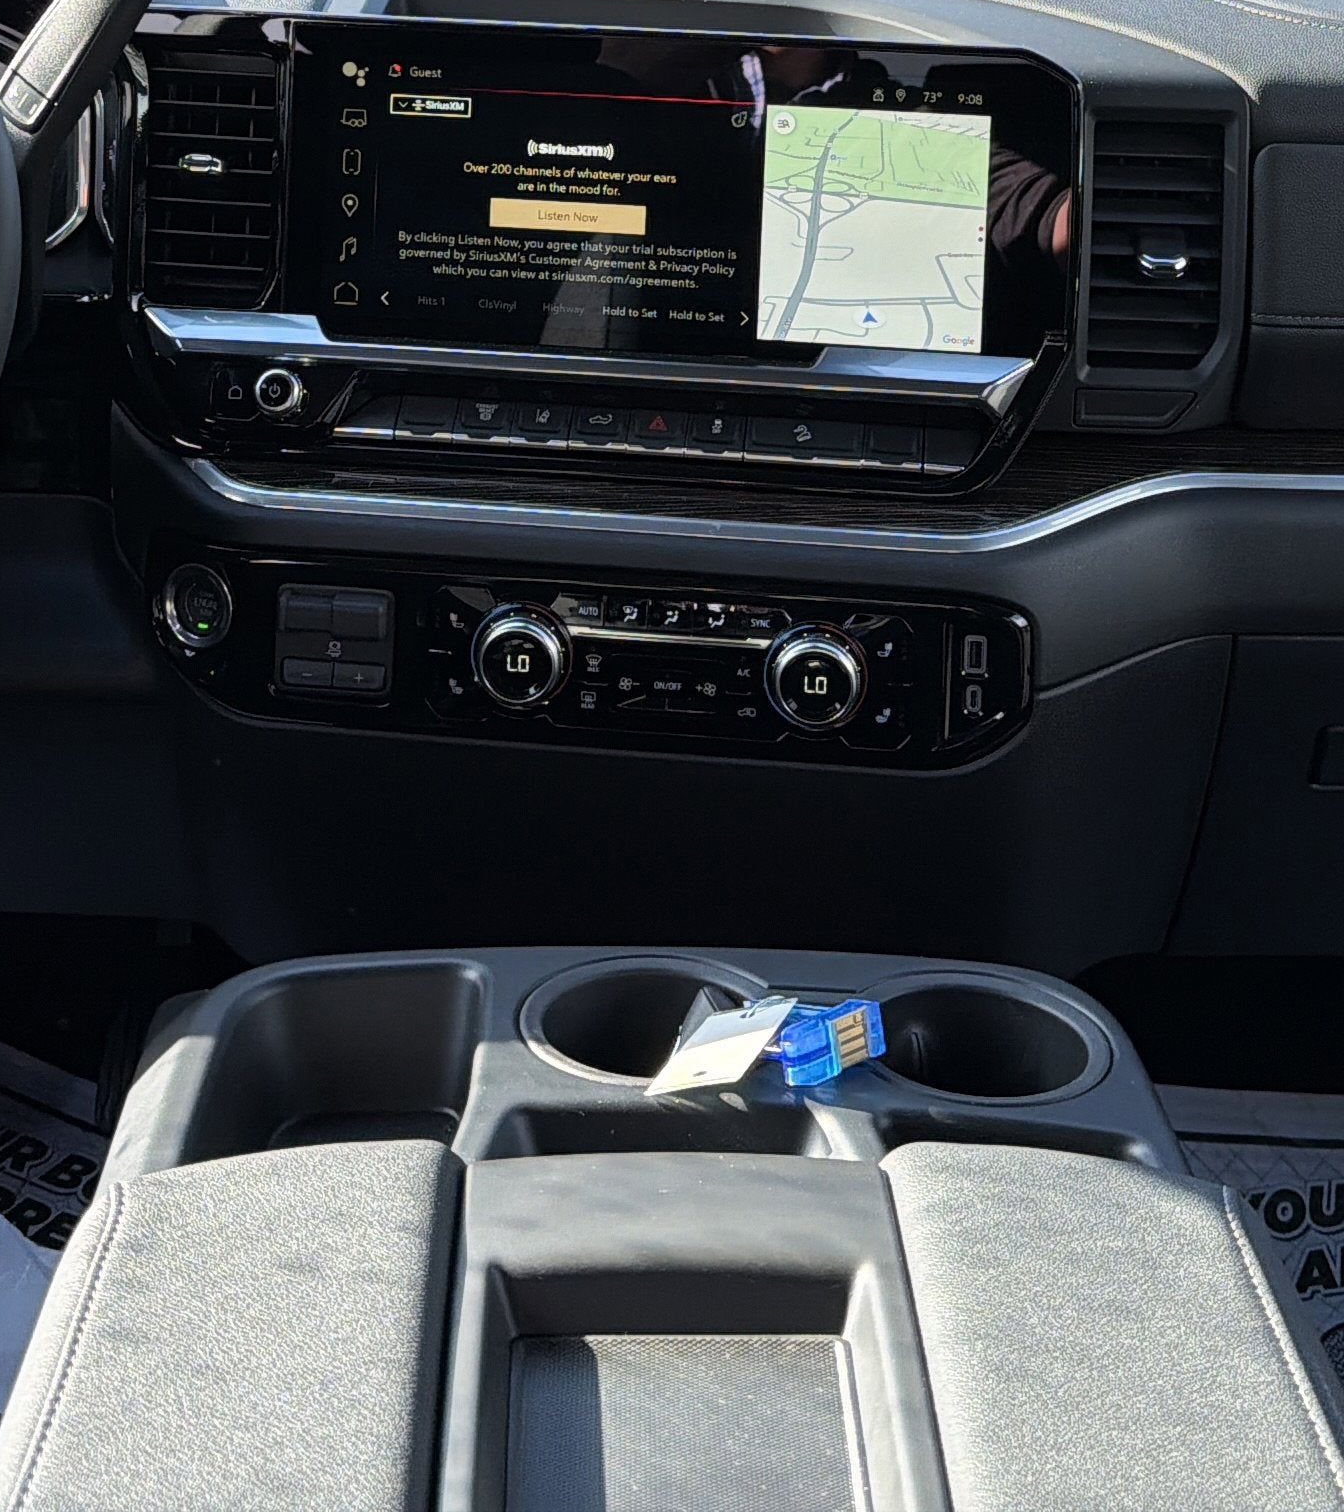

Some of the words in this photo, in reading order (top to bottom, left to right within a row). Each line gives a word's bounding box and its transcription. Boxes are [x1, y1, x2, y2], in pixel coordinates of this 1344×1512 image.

[409, 66, 442, 78] Guest
[425, 100, 465, 111] SiriusXM
[922, 92, 943, 103] 73°
[957, 93, 983, 106] 9:08
[464, 162, 489, 173] Over
[490, 164, 512, 175] 200
[513, 165, 561, 178] channels
[563, 166, 576, 178] of
[577, 168, 625, 181] whatever
[627, 172, 651, 184] your
[654, 172, 677, 184] ears
[517, 182, 535, 192] are
[537, 181, 547, 192] in
[549, 182, 567, 193] the
[569, 183, 601, 195] mood
[603, 184, 621, 196] for.
[538, 210, 571, 222] Listen
[573, 212, 599, 223] Now
[398, 230, 413, 245] By
[414, 232, 456, 247] clicking
[458, 234, 491, 247] Listen
[494, 236, 522, 249] Now,
[524, 240, 545, 252] you
[546, 240, 579, 253] agree
[580, 240, 603, 252] that
[604, 245, 630, 256] your
[632, 244, 655, 256] trial
[656, 246, 725, 261] subscription
[728, 248, 738, 260] is
[399, 248, 451, 261] governed
[454, 249, 467, 263] by
[468, 250, 527, 264] SiriusXM's
[528, 253, 582, 267] Customer
[584, 256, 646, 272] Agreement
[648, 260, 657, 271] &
[660, 260, 699, 276] Privacy
[702, 262, 736, 279] Policy
[432, 264, 465, 276] which
[466, 266, 488, 279] you
[489, 268, 509, 278] can
[511, 268, 536, 280] view
[538, 270, 550, 281] at
[552, 270, 699, 289] siriusxm.com/agreements.
[417, 296, 438, 307] Hits
[478, 298, 517, 313] ClsVinyl
[542, 302, 585, 317] Highway
[602, 306, 626, 317] Hold
[628, 308, 639, 318] to
[641, 308, 658, 319] Set
[668, 310, 693, 321] Hold
[694, 310, 706, 322] to
[708, 312, 726, 323] Set
[942, 334, 975, 347] Google
[578, 606, 599, 617] AUTO
[750, 618, 771, 629] SYNC
[506, 654, 530, 673] LO
[736, 668, 751, 678] A/C
[654, 680, 683, 692] ON/OFF
[804, 675, 828, 695] LO
